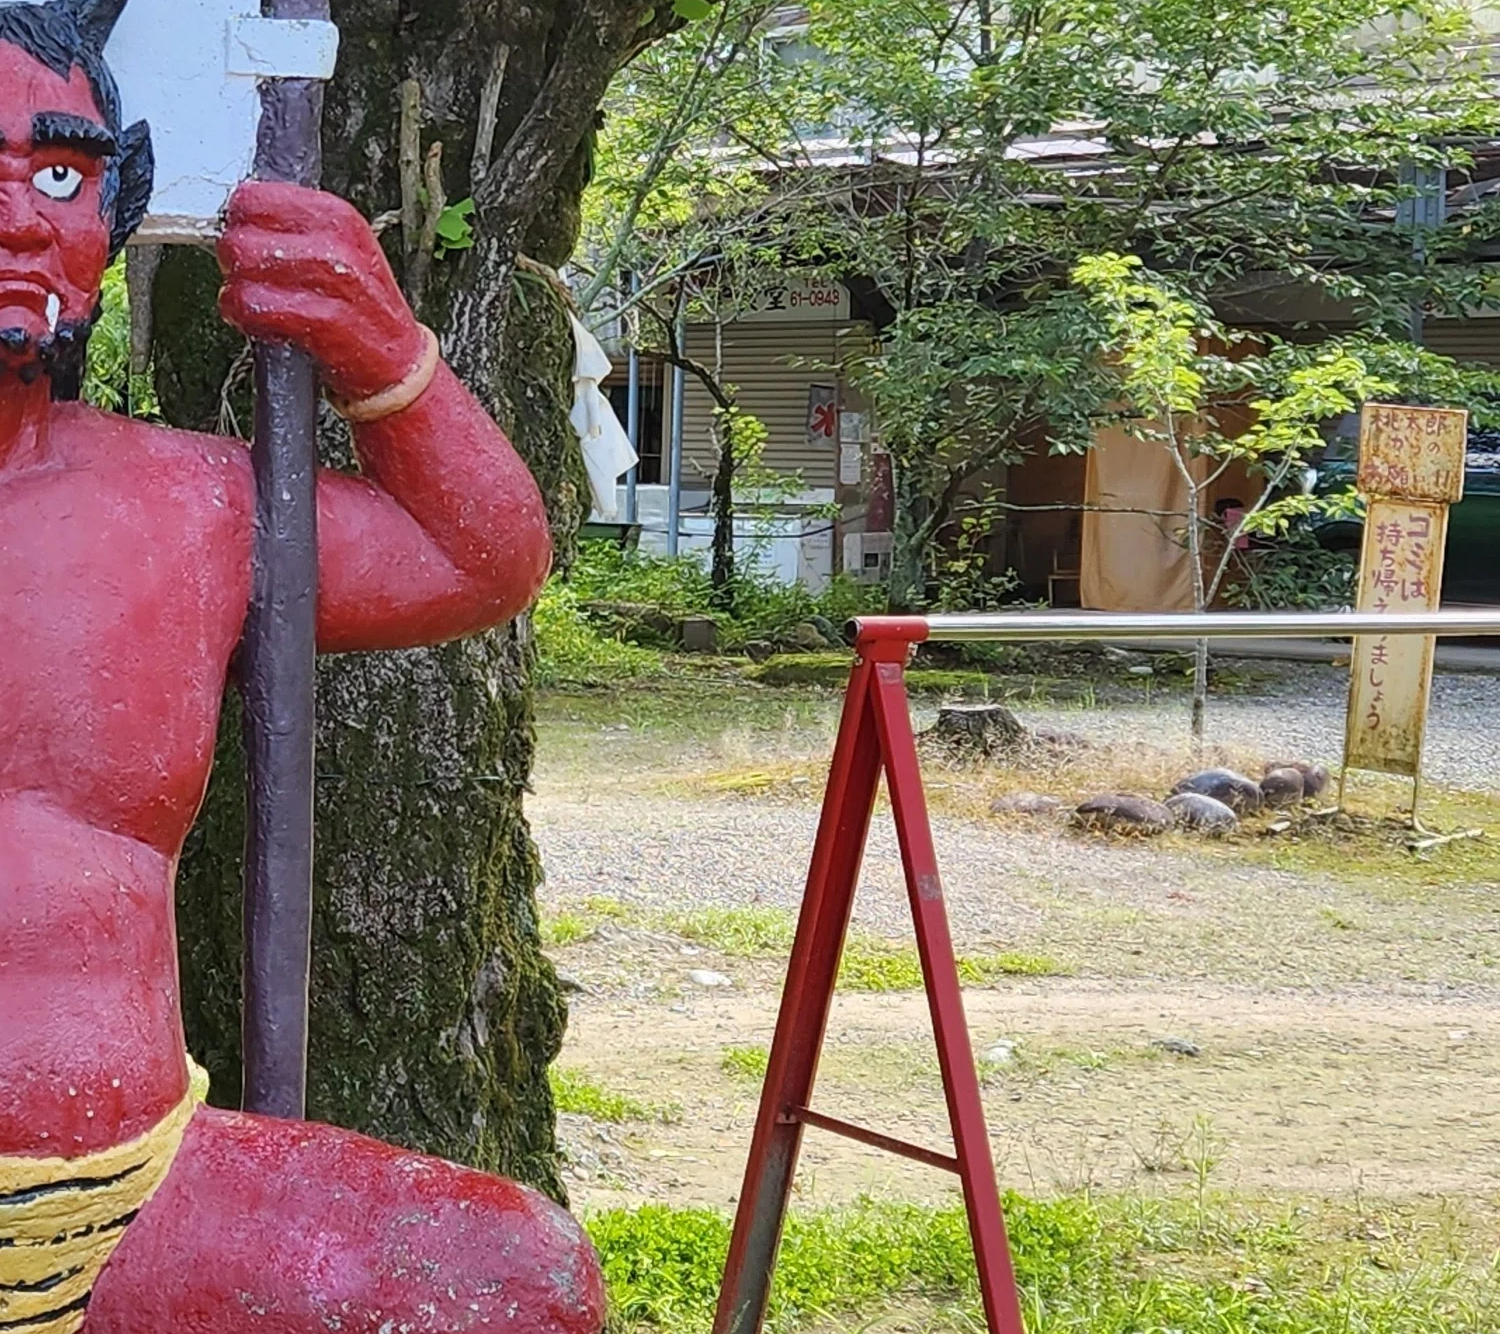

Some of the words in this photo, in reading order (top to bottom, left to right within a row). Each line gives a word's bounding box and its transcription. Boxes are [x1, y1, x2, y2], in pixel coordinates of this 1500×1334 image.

[1370, 409, 1447, 437] 桃太郎
[1401, 512, 1432, 601] ゴミは
